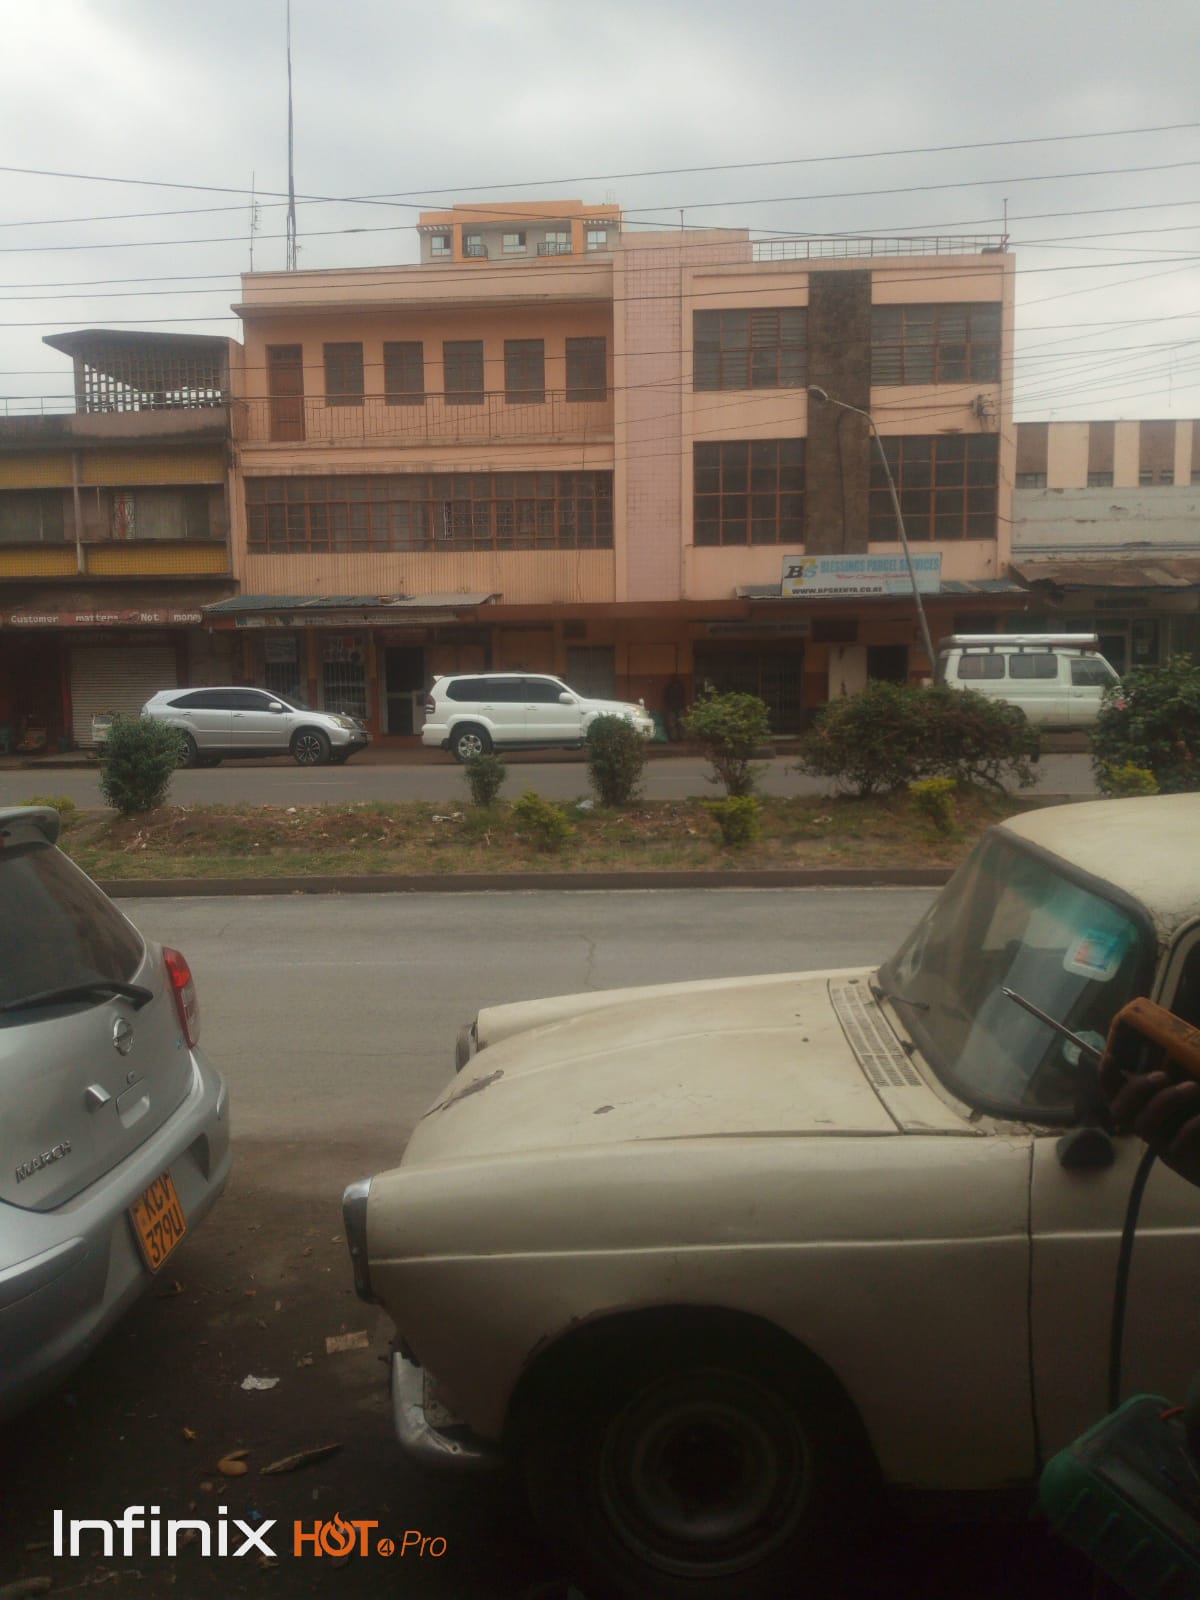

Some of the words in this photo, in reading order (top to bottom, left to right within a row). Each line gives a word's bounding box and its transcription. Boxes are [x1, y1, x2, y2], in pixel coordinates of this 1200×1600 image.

[820, 559, 865, 573] BLESSINGS
[867, 558, 897, 572] PARCEL
[11, 615, 59, 623] Customer
[75, 614, 119, 622] matters
[140, 613, 160, 622] Not
[173, 613, 203, 623] money
[15, 1140, 72, 1184] MARCH
[146, 1204, 183, 1263] 379U
